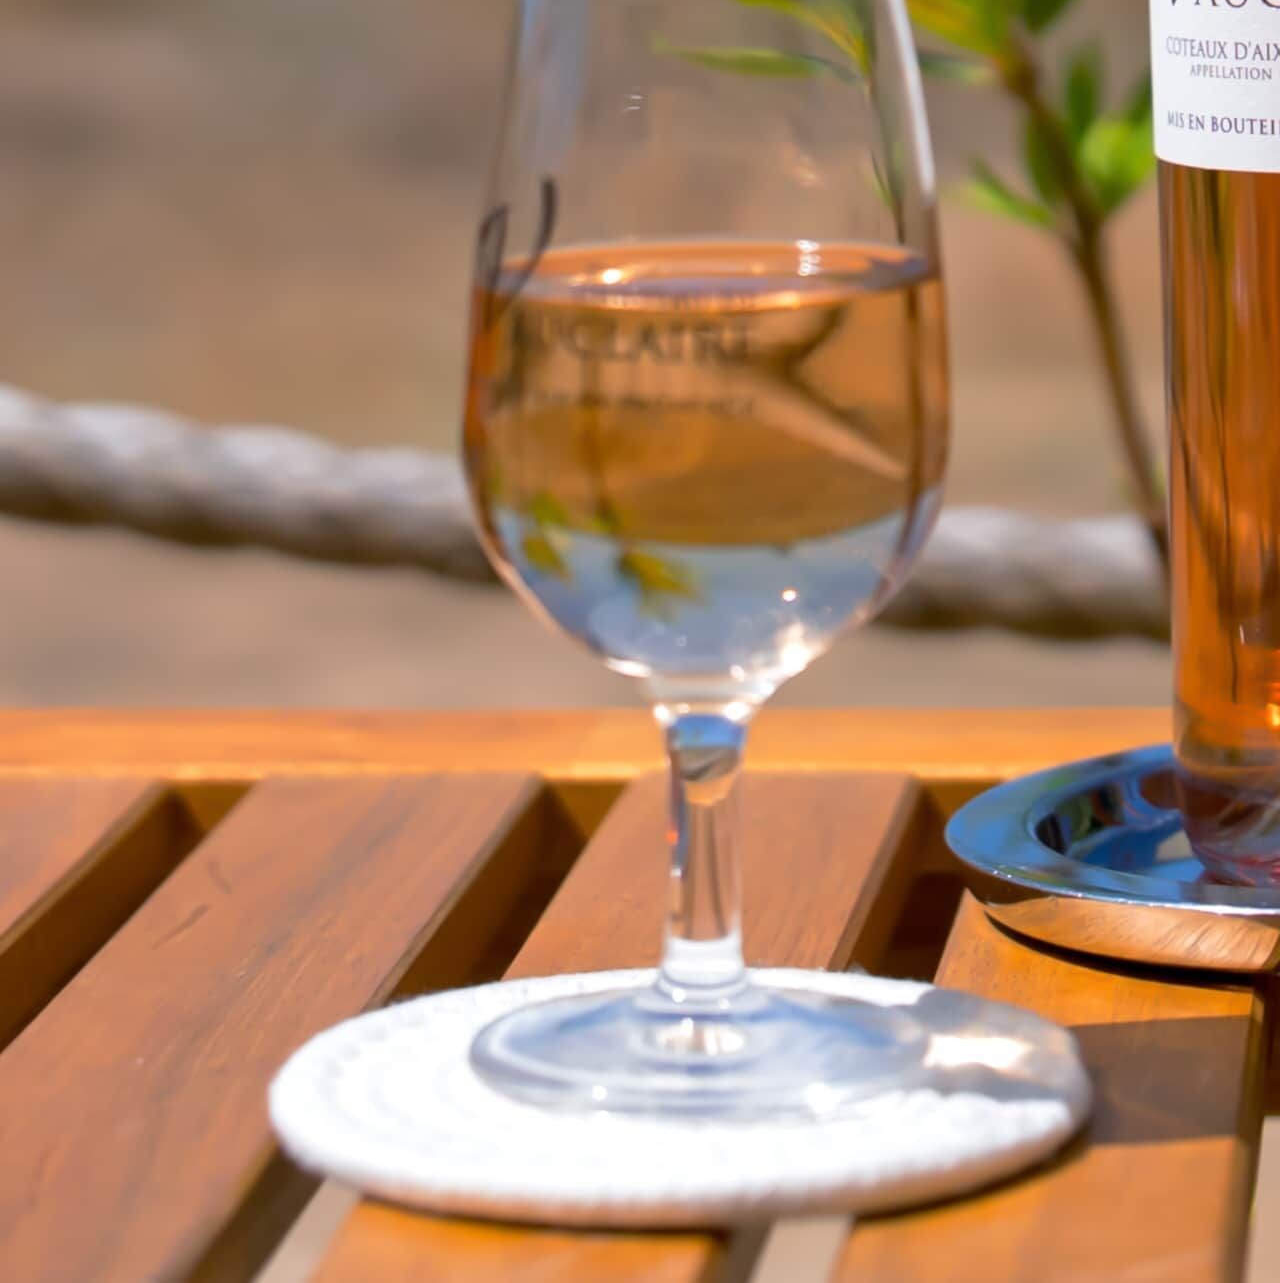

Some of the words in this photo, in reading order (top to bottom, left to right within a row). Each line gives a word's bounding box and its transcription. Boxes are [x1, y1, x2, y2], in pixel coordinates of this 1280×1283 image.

[1166, 36, 1228, 60] COTEAUX
[1190, 64, 1273, 81] APPELLATION
[1167, 110, 1185, 129] MIS
[1188, 113, 1206, 131] EN
